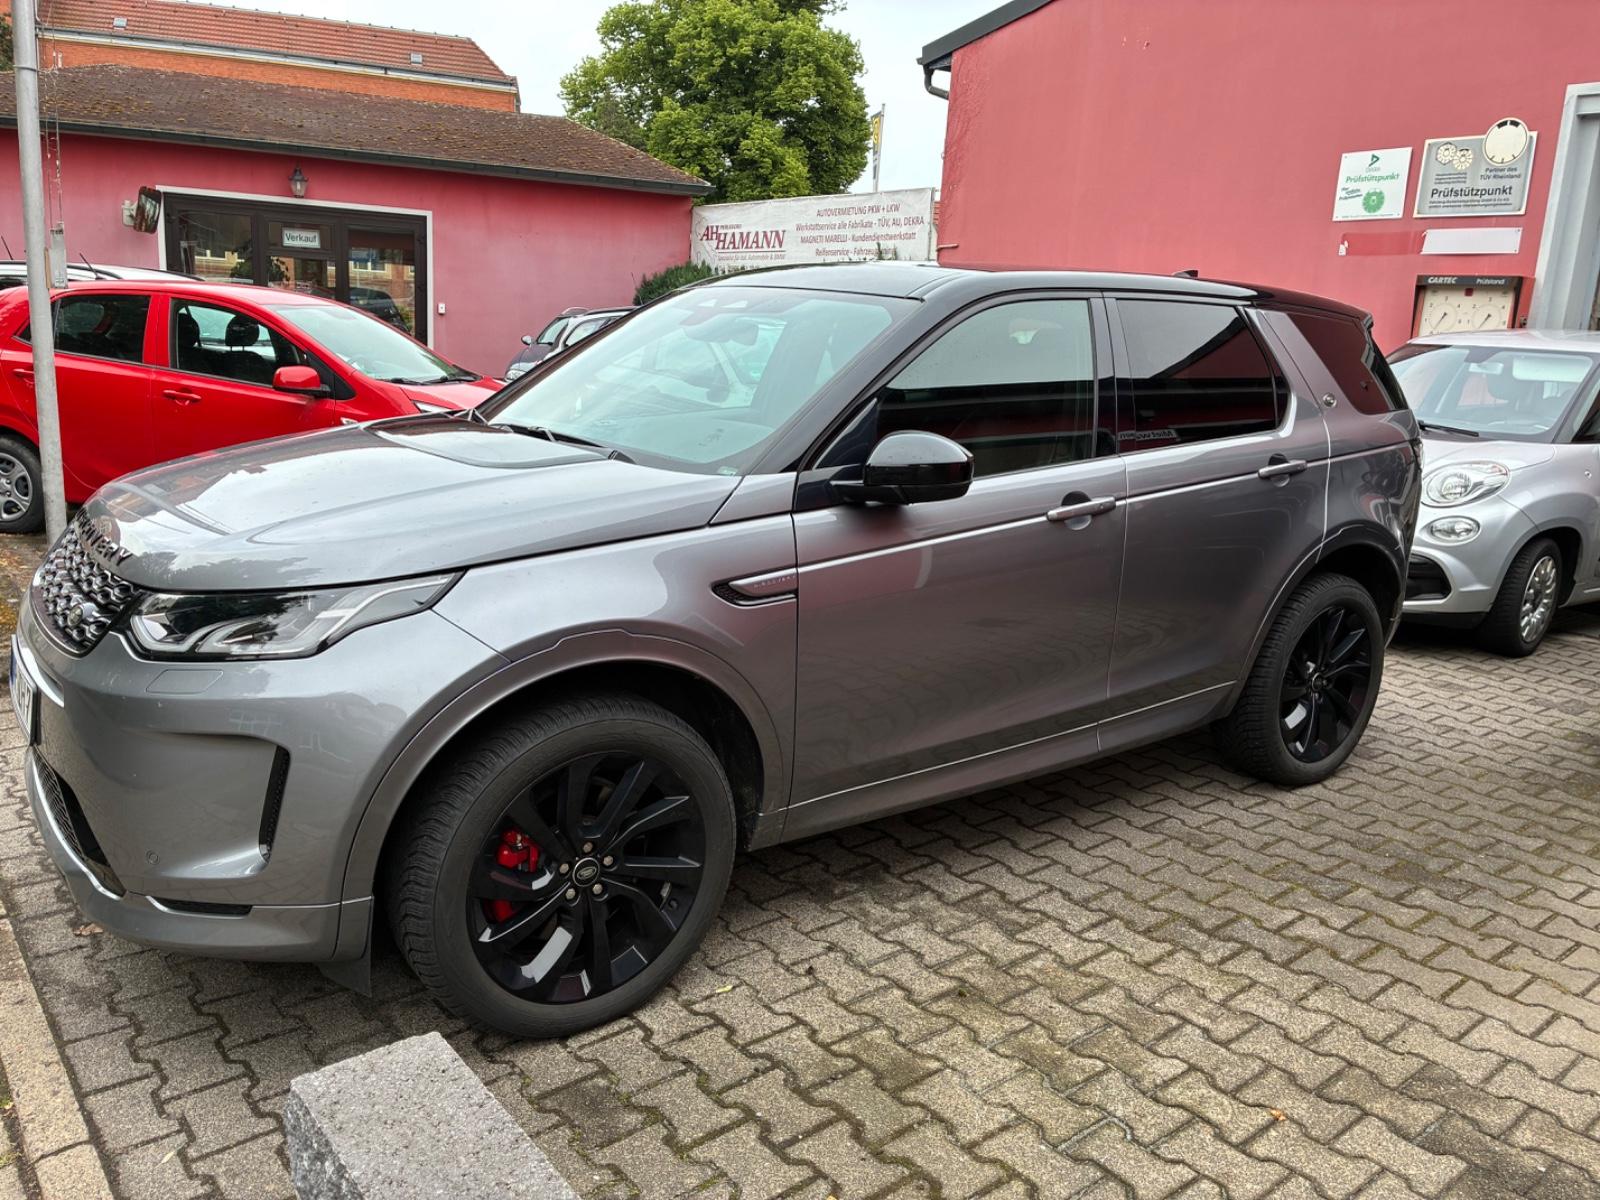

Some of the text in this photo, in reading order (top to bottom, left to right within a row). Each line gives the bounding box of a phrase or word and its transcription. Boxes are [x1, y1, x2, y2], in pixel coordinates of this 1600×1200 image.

[1431, 185, 1513, 199] Prüfstützpunkt
[816, 206, 867, 217] AUTOVERMIETUNG
[868, 204, 882, 214] PKW
[886, 203, 901, 212] LKW
[795, 221, 837, 231] Werkstattservice
[838, 220, 847, 230] alle
[848, 217, 873, 229] Fabrikate
[878, 217, 891, 228] TÜV,
[891, 217, 903, 228] AU,
[904, 215, 925, 226] DEKRA
[285, 233, 317, 243] Verkauf
[700, 225, 719, 241] AH
[715, 230, 787, 250] HAMANN
[800, 234, 824, 244] MAGNETI
[825, 233, 848, 243] MARELLI
[852, 231, 917, 242] Kundendienstwerkstatt
[815, 247, 849, 257] Reifenservice
[1428, 276, 1458, 284] CARTEC
